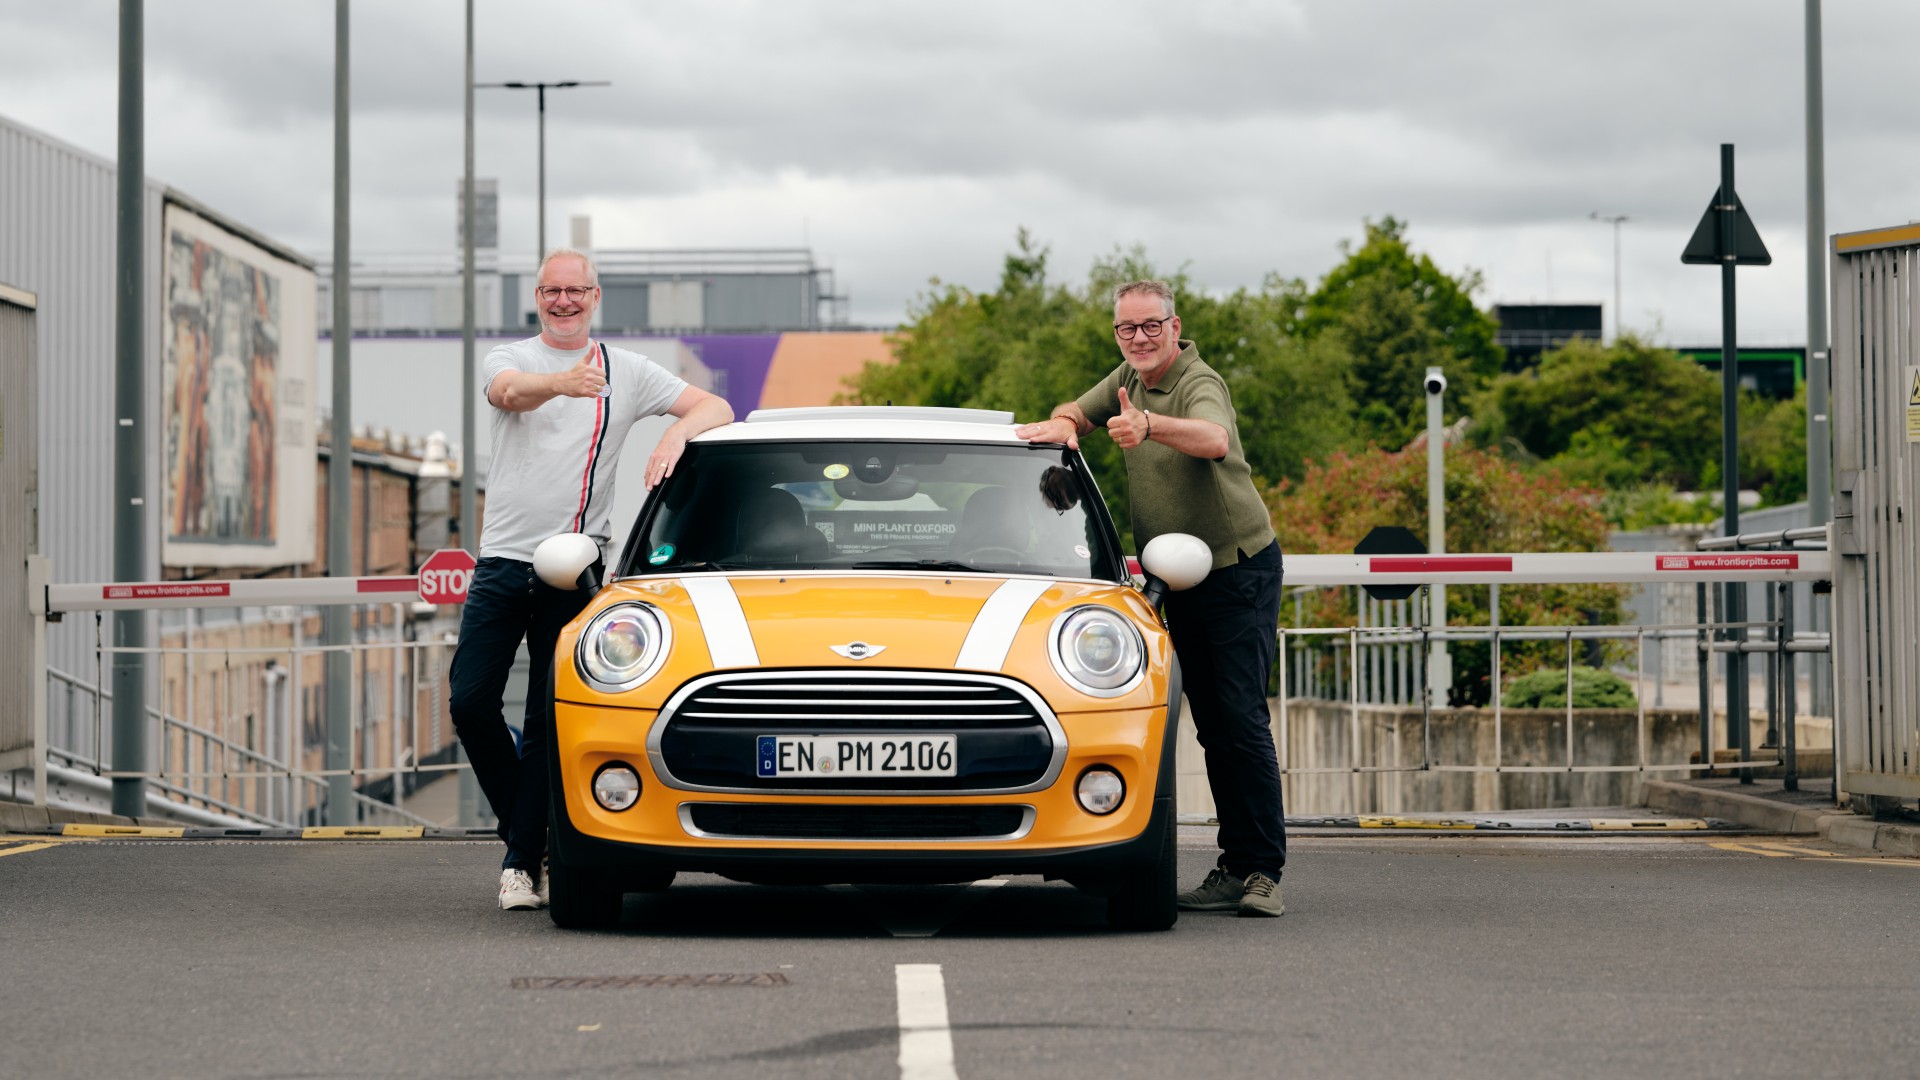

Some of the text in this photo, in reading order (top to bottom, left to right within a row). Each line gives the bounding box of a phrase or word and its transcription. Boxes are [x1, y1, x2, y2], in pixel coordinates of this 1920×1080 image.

[854, 523, 956, 534] MINI PLANT OXFORD
[1693, 557, 1790, 567] www.frontierpitts.com
[136, 585, 223, 596] www.frontierpitts.com
[778, 741, 952, 771] EN PM 2106
[764, 760, 772, 769] D
